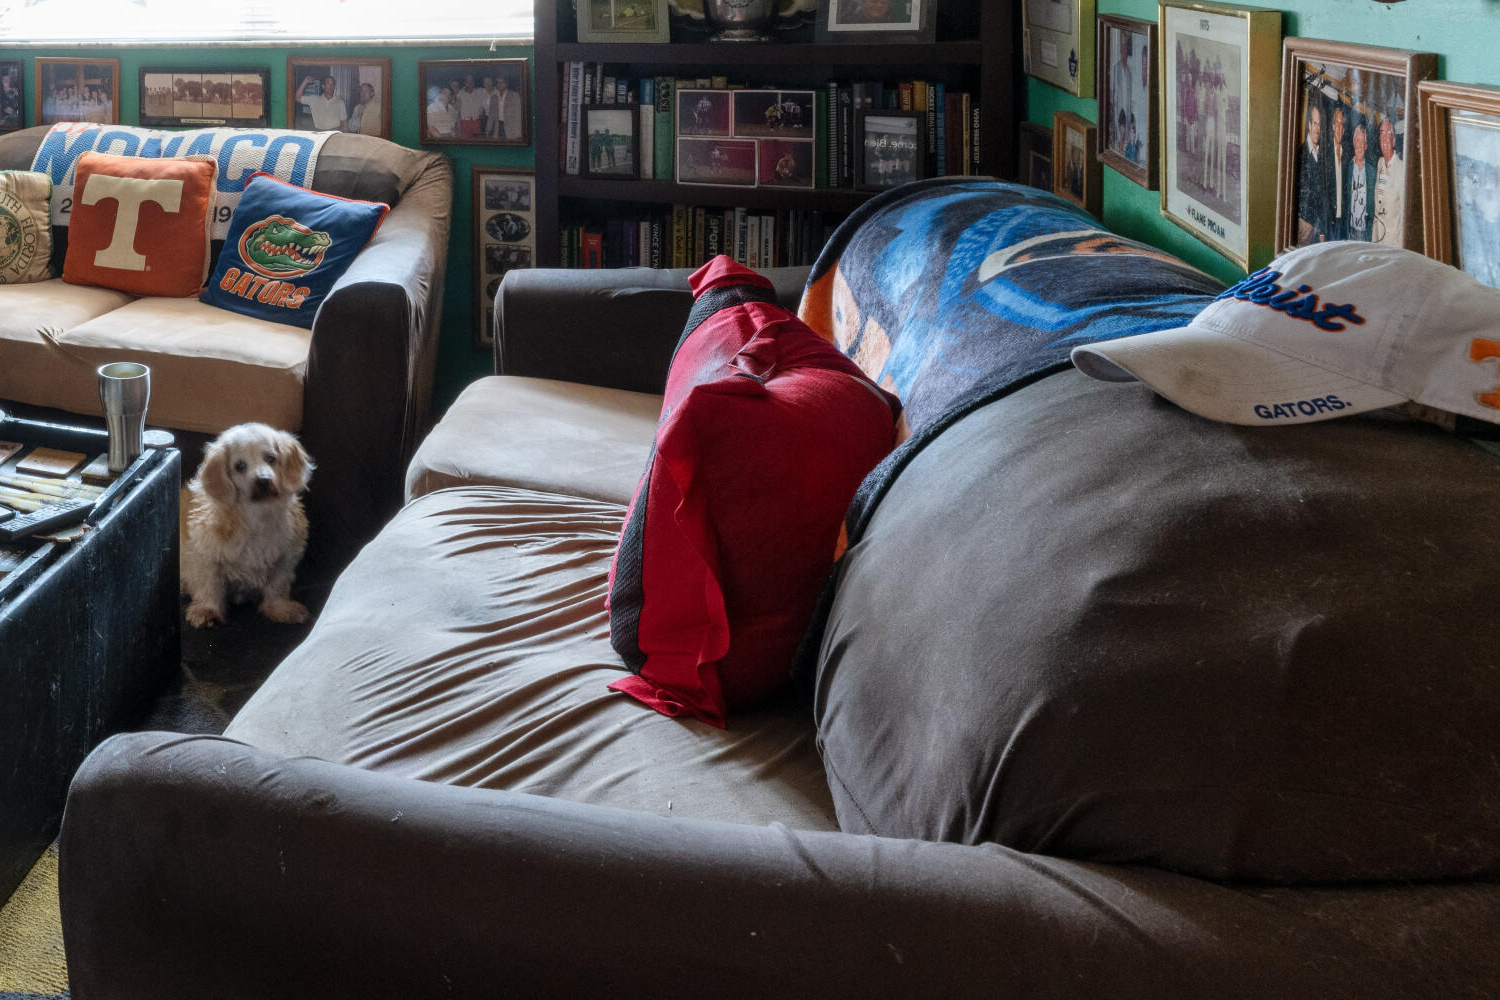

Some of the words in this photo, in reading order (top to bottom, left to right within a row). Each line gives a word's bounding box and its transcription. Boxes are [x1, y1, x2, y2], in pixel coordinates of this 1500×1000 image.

[81, 173, 184, 271] T
[651, 223, 660, 248] VINCE
[10, 215, 37, 276] FLORIDA
[219, 267, 310, 309] GATORS
[1254, 394, 1352, 420] GATORS.
